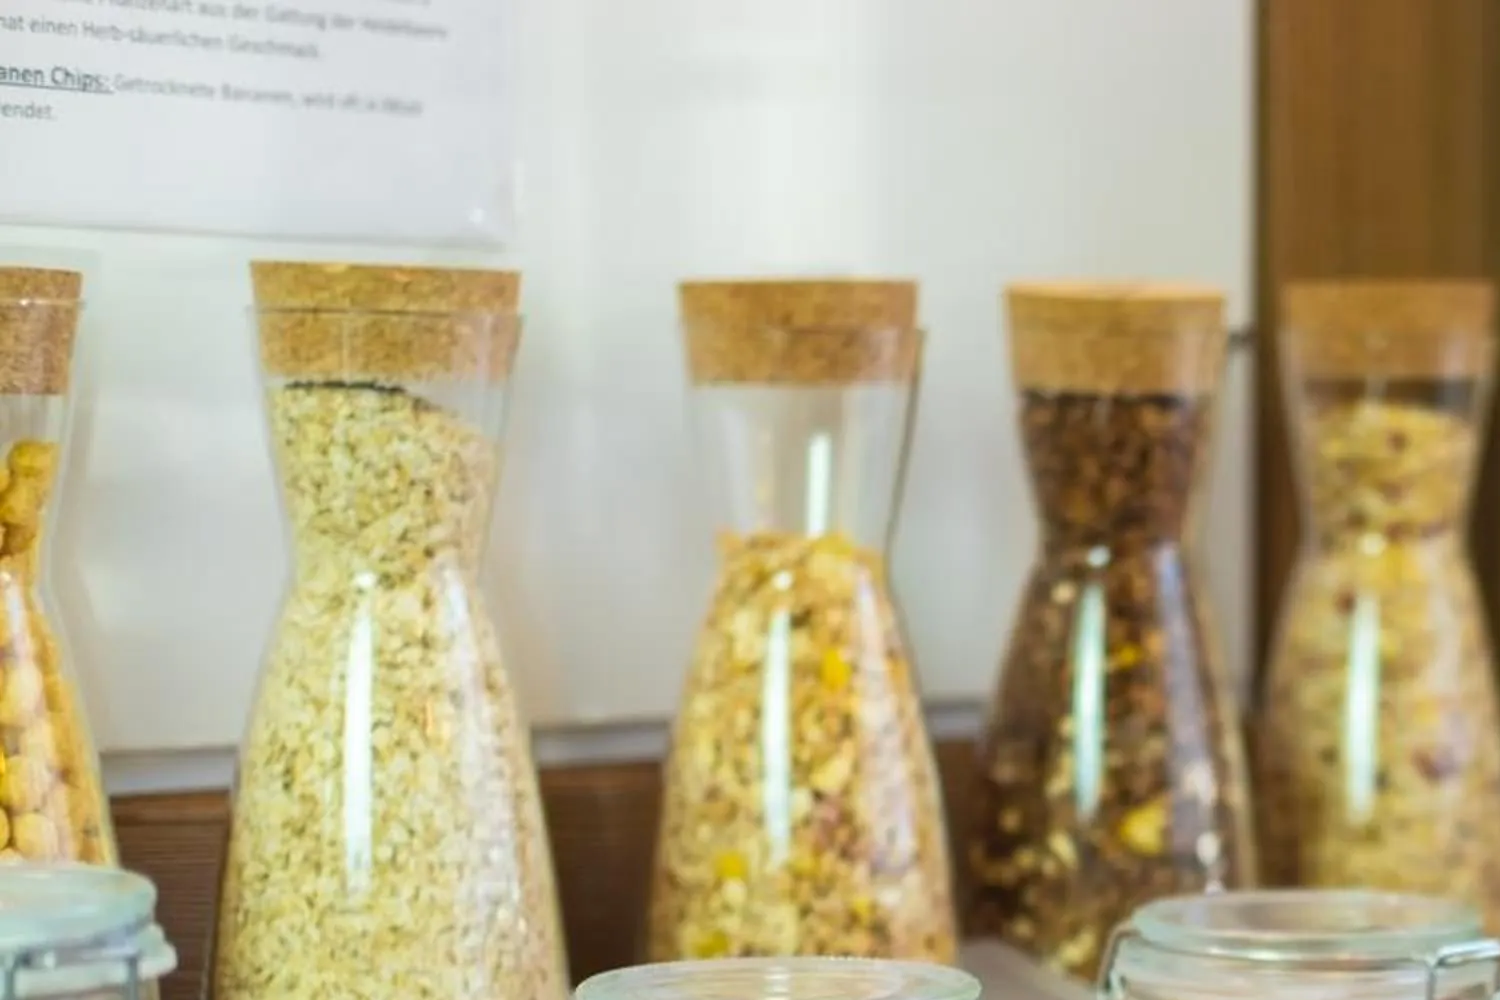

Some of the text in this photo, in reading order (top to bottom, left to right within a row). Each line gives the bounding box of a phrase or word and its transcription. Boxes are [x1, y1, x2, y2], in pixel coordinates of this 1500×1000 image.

[29, 16, 78, 37] einen
[50, 66, 114, 93] Chips:
[0, 101, 57, 121] endet.
